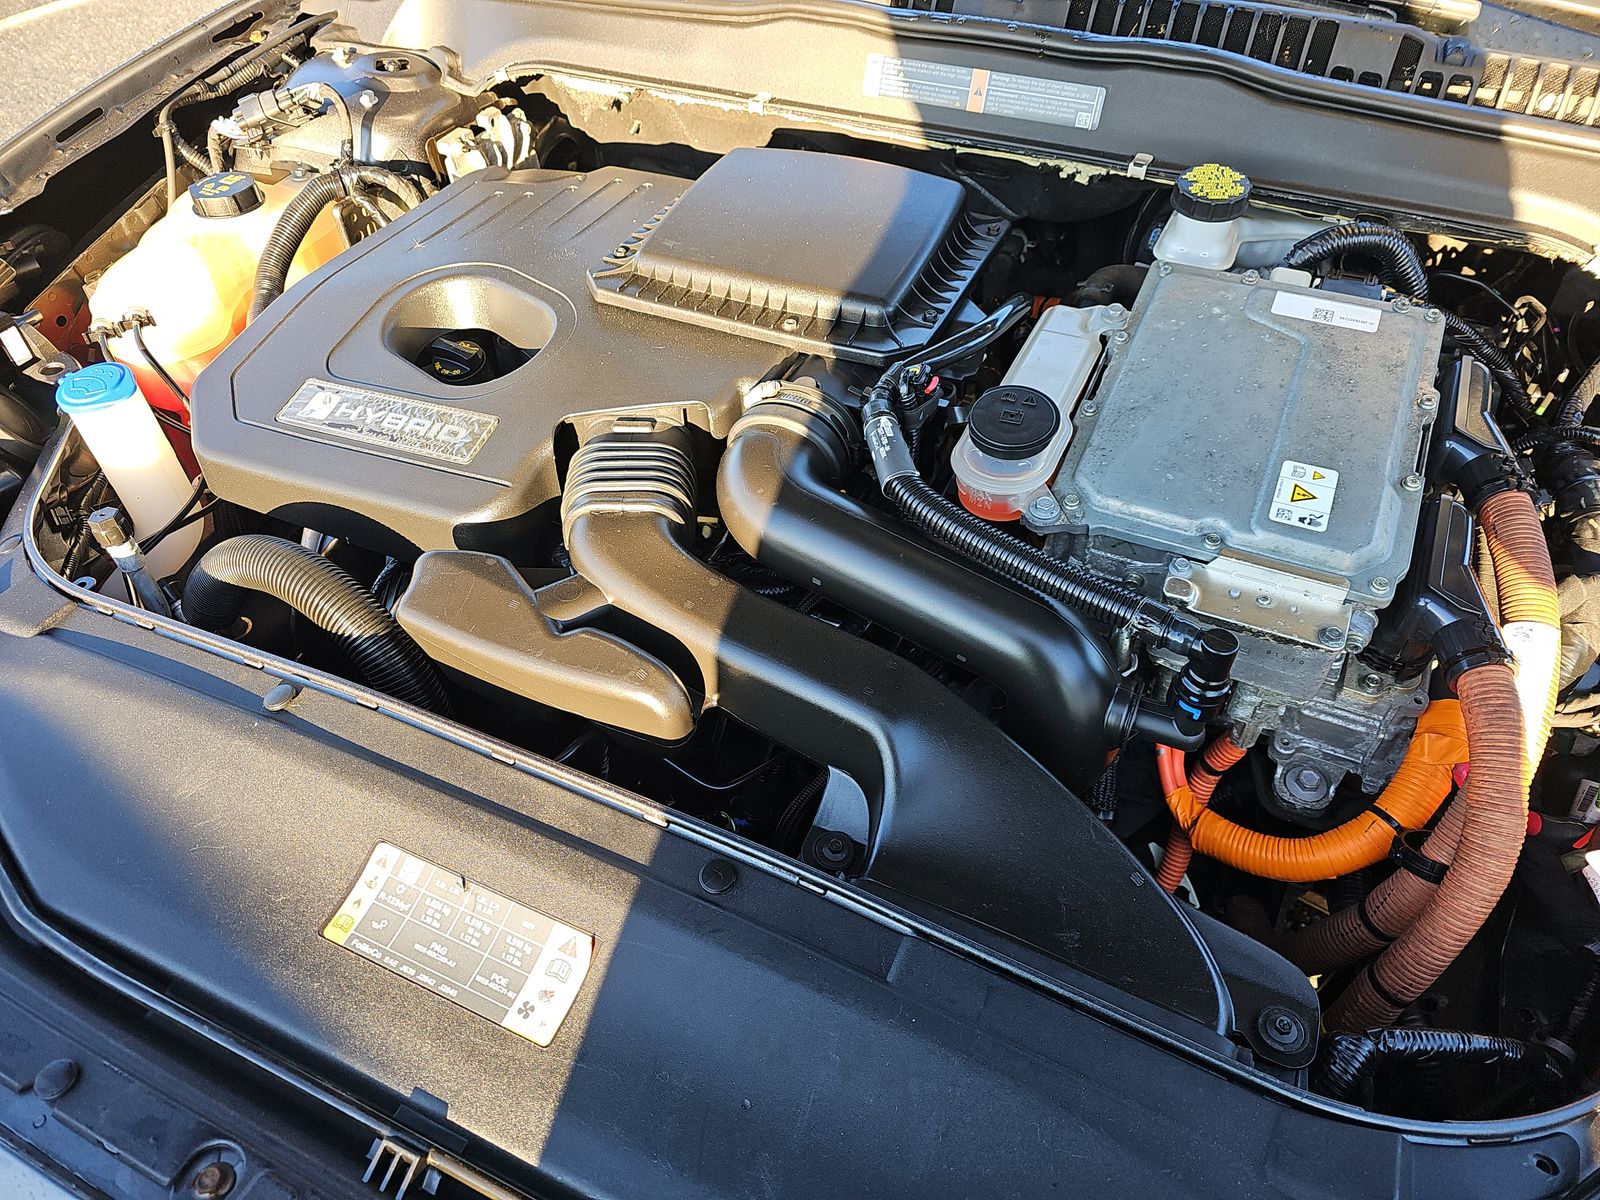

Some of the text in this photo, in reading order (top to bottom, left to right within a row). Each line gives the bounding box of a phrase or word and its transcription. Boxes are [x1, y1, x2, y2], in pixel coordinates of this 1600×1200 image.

[334, 402, 468, 444] HYBRID
[350, 938, 383, 959] FoMoCo
[383, 956, 400, 968] SAE
[429, 941, 449, 956] PAG
[490, 972, 510, 988] POE
